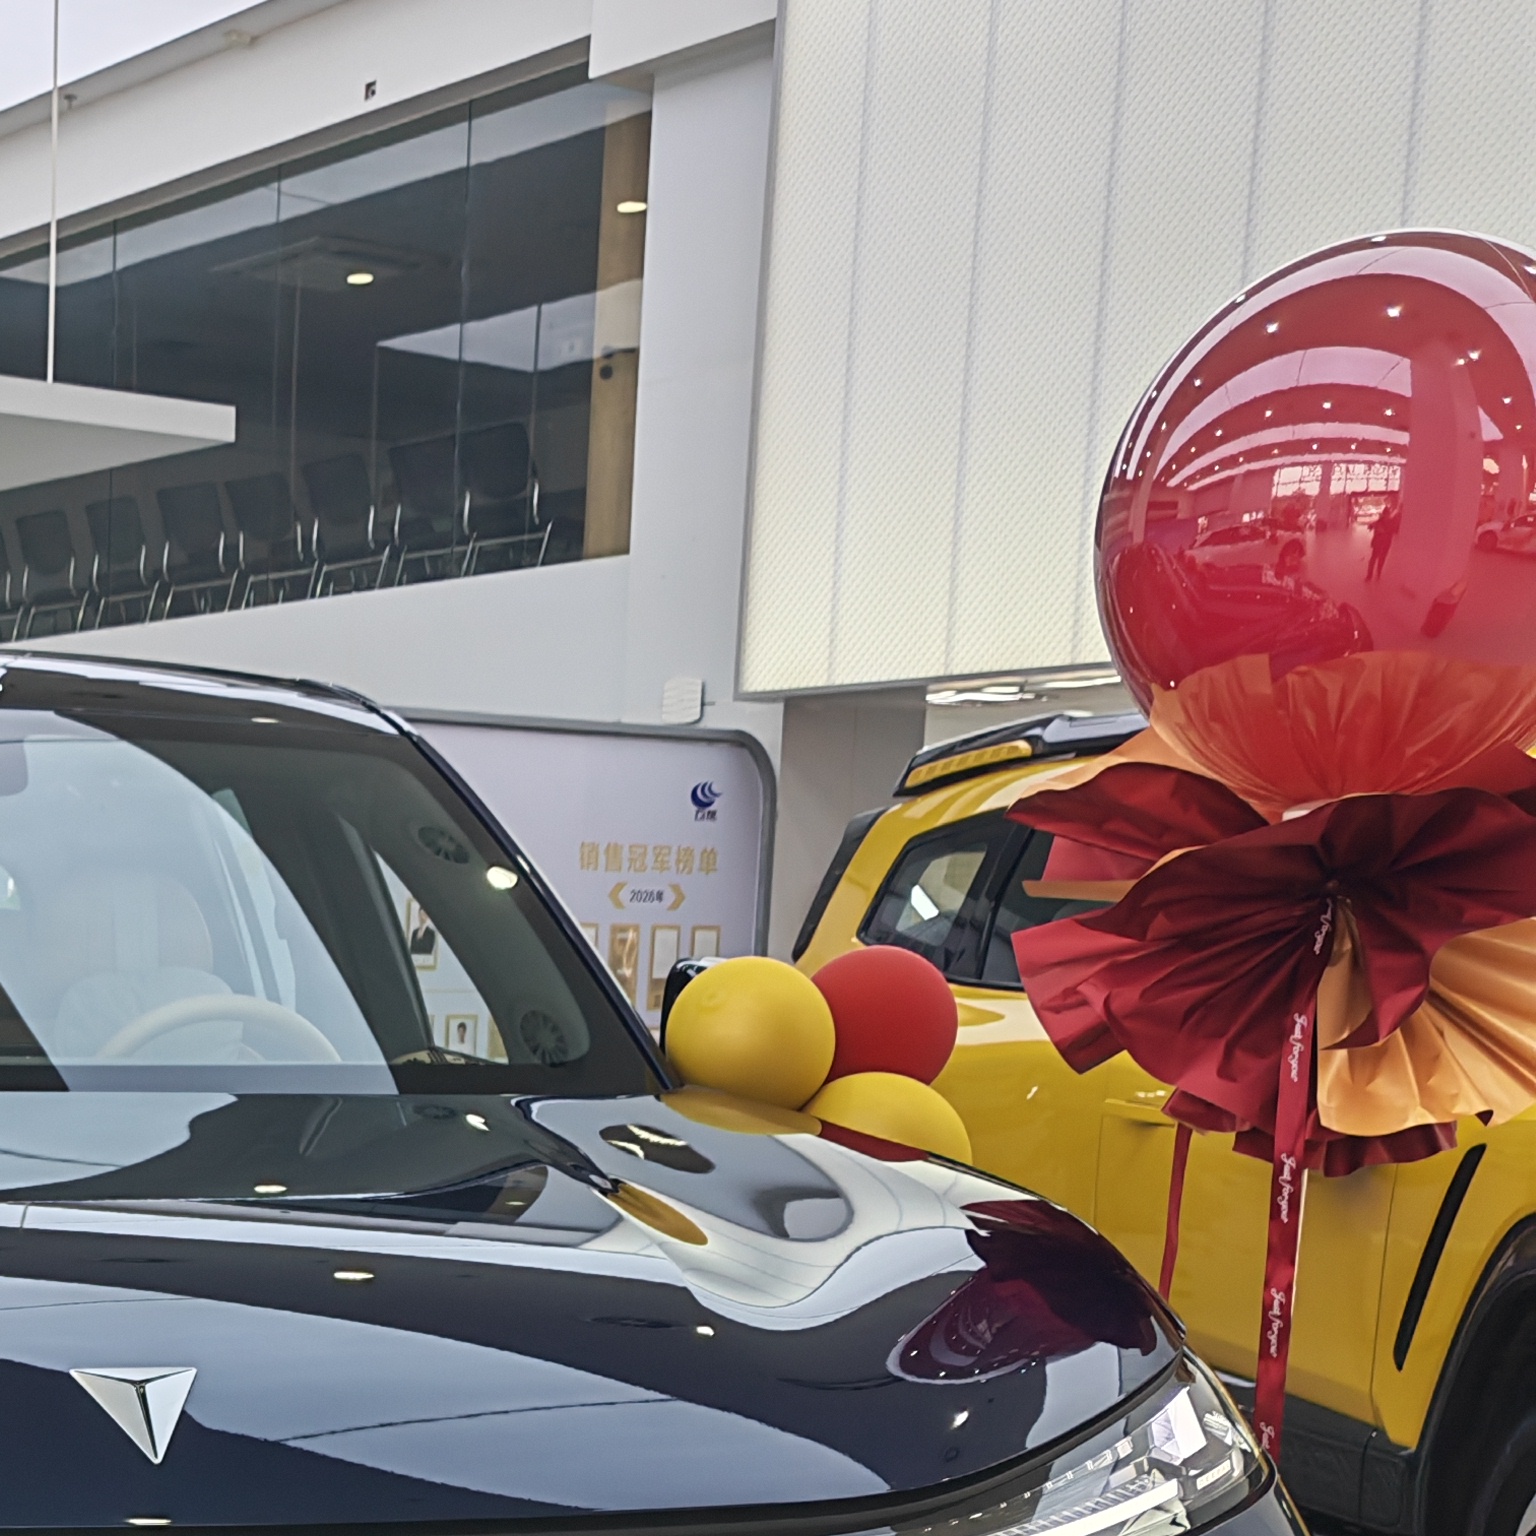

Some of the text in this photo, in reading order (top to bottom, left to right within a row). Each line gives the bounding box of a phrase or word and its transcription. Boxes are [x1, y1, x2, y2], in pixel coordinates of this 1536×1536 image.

[579, 841, 718, 875] 销售冠军榜单
